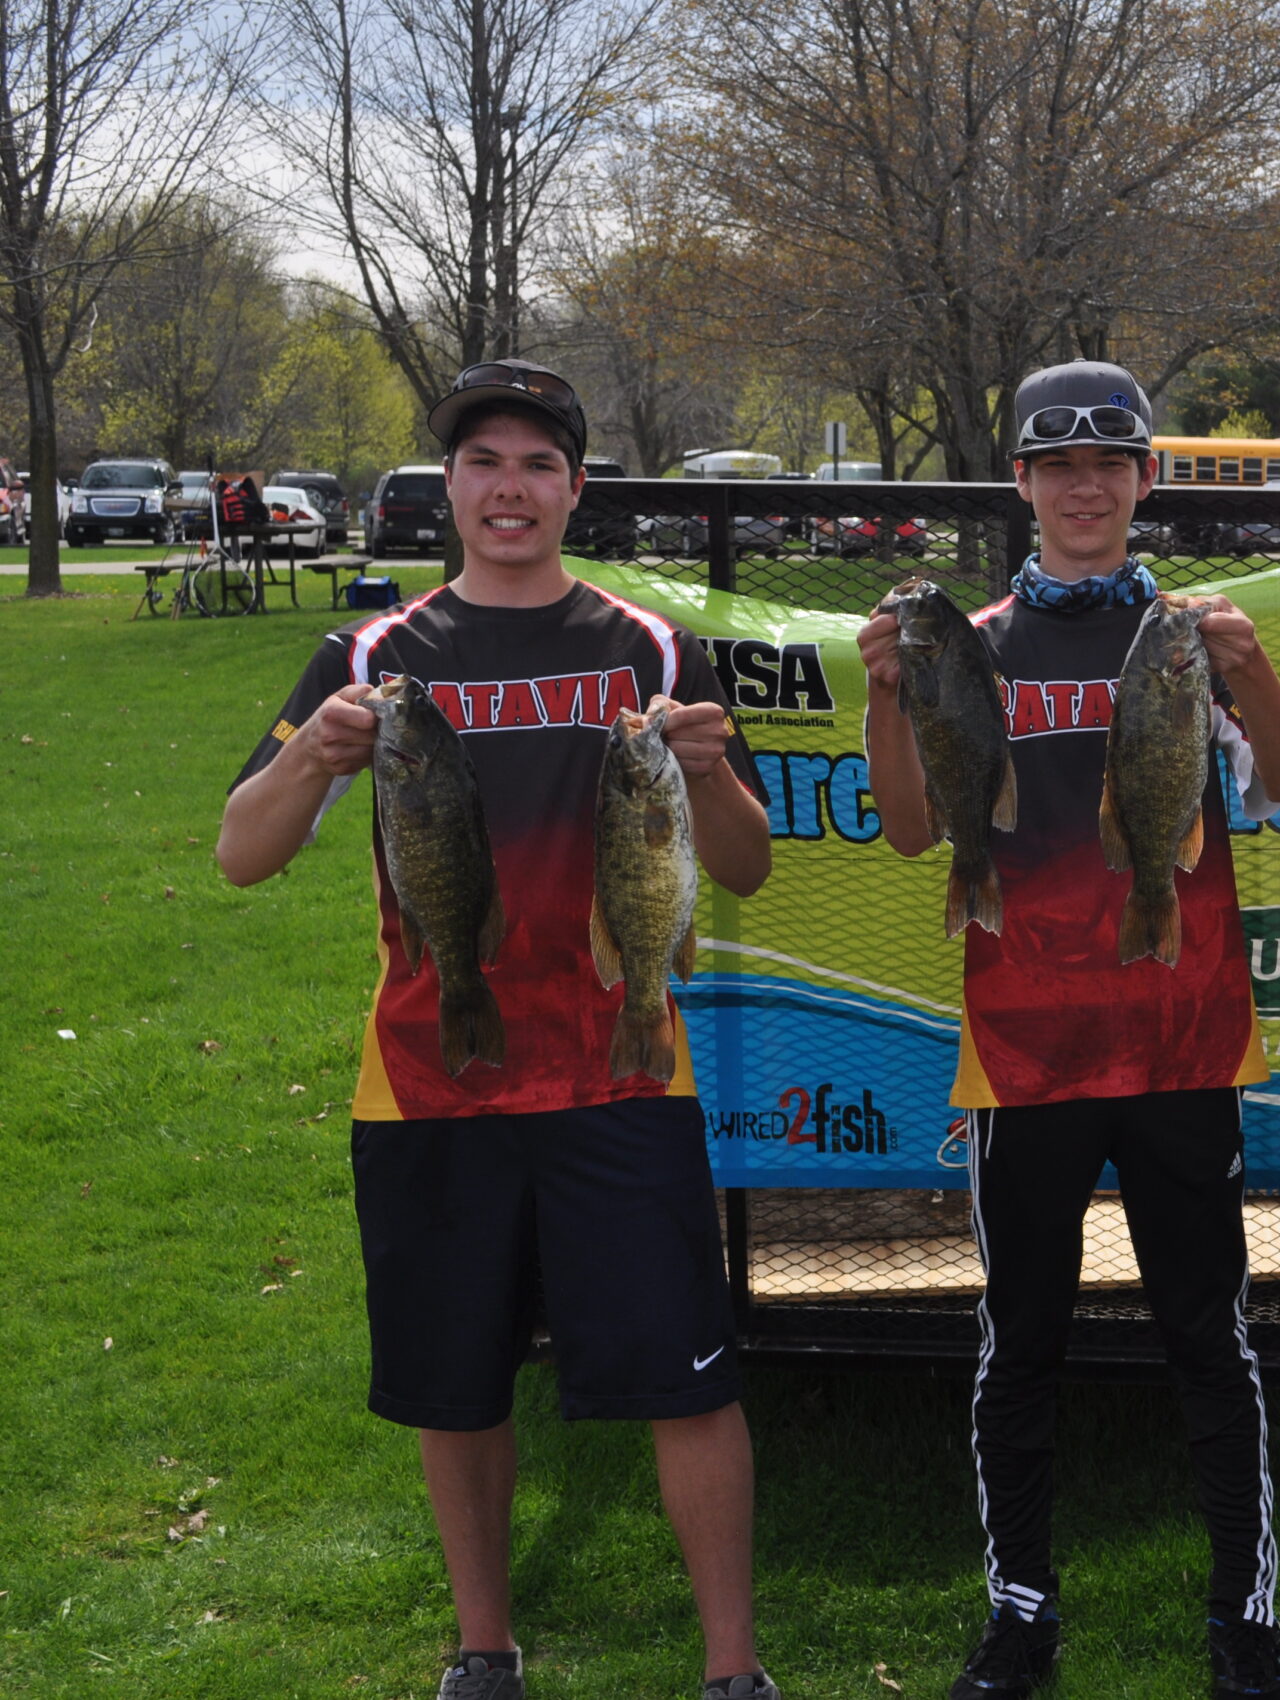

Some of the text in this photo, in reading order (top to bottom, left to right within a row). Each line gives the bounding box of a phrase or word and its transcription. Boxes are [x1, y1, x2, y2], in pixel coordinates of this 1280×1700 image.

[380, 666, 642, 734] ATAVIA
[736, 714, 763, 726] hool
[766, 714, 834, 727] Association
